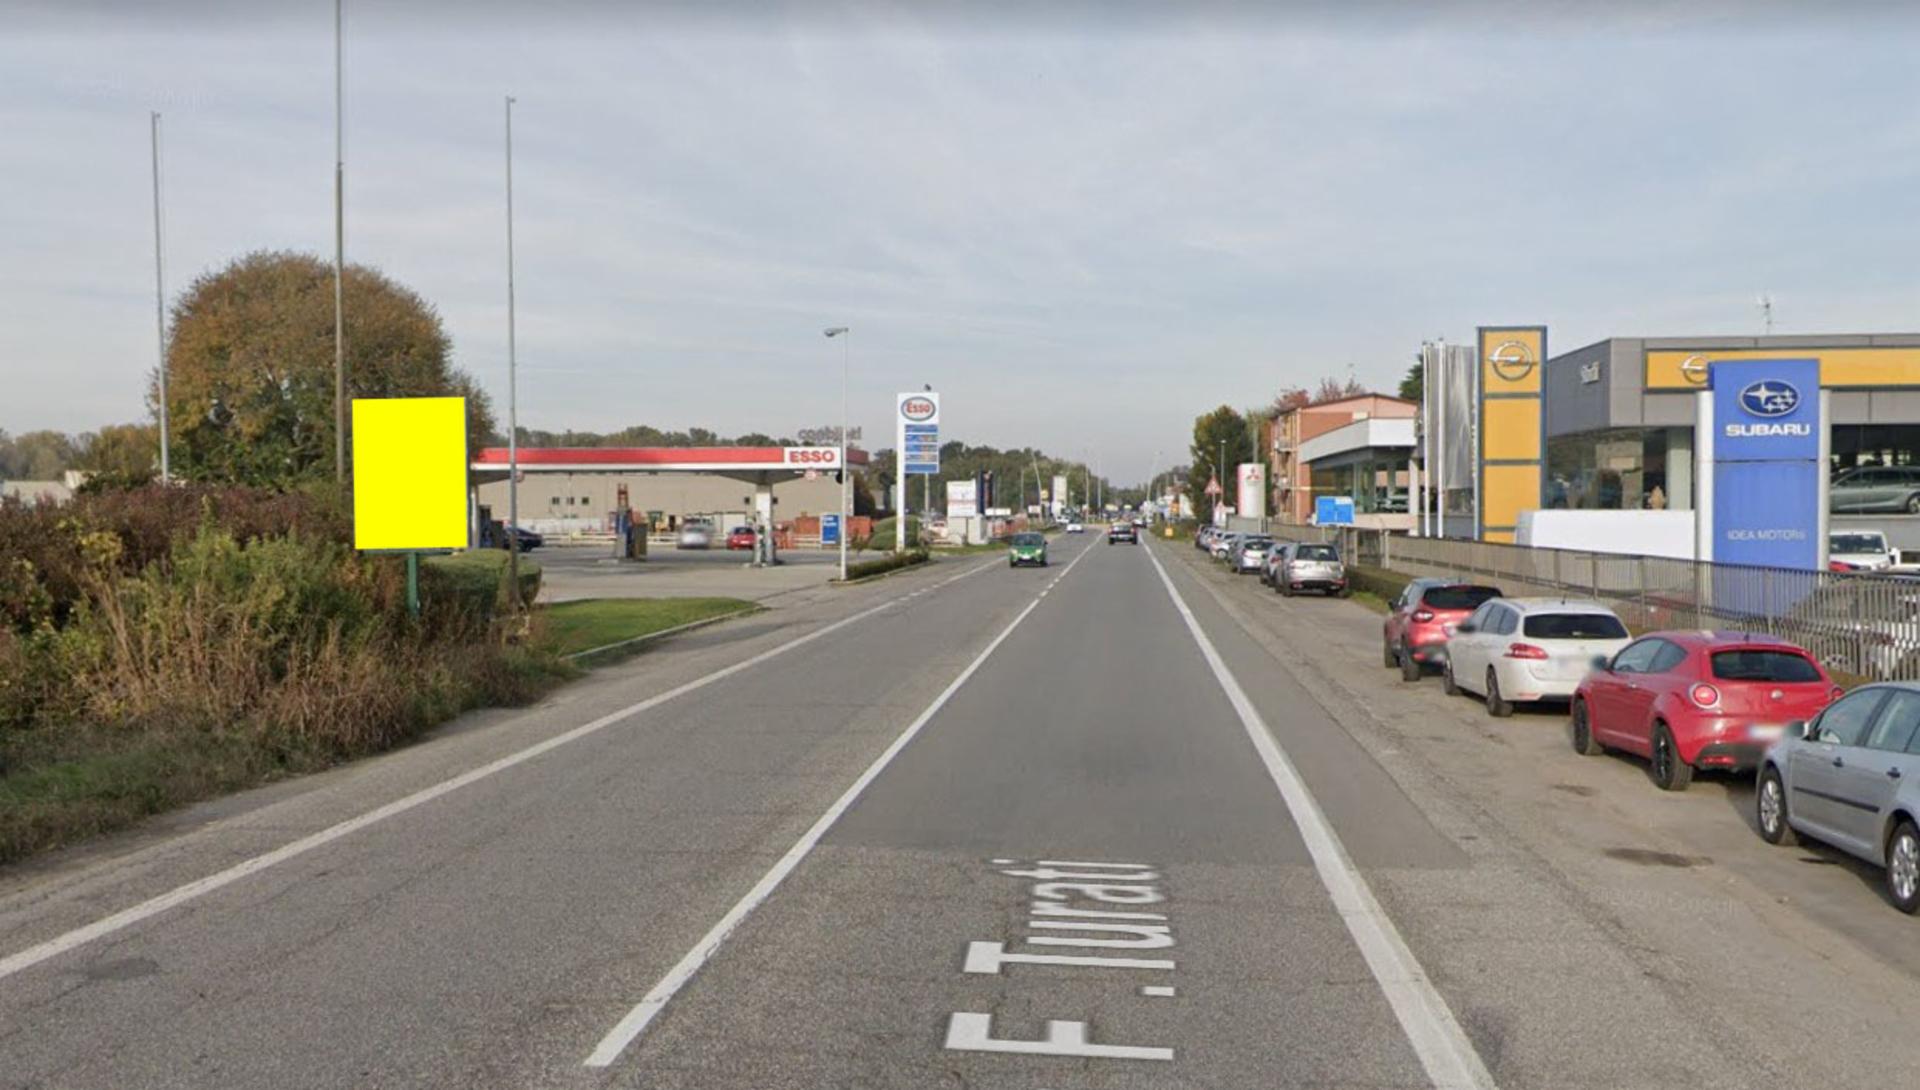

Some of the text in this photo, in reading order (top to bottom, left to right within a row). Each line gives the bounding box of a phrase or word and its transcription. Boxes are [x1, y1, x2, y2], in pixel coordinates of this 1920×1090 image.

[907, 402, 930, 413] Esso
[1726, 423, 1810, 437] SUBARU
[789, 450, 834, 463] ESSO
[1728, 530, 1756, 540] IDEA
